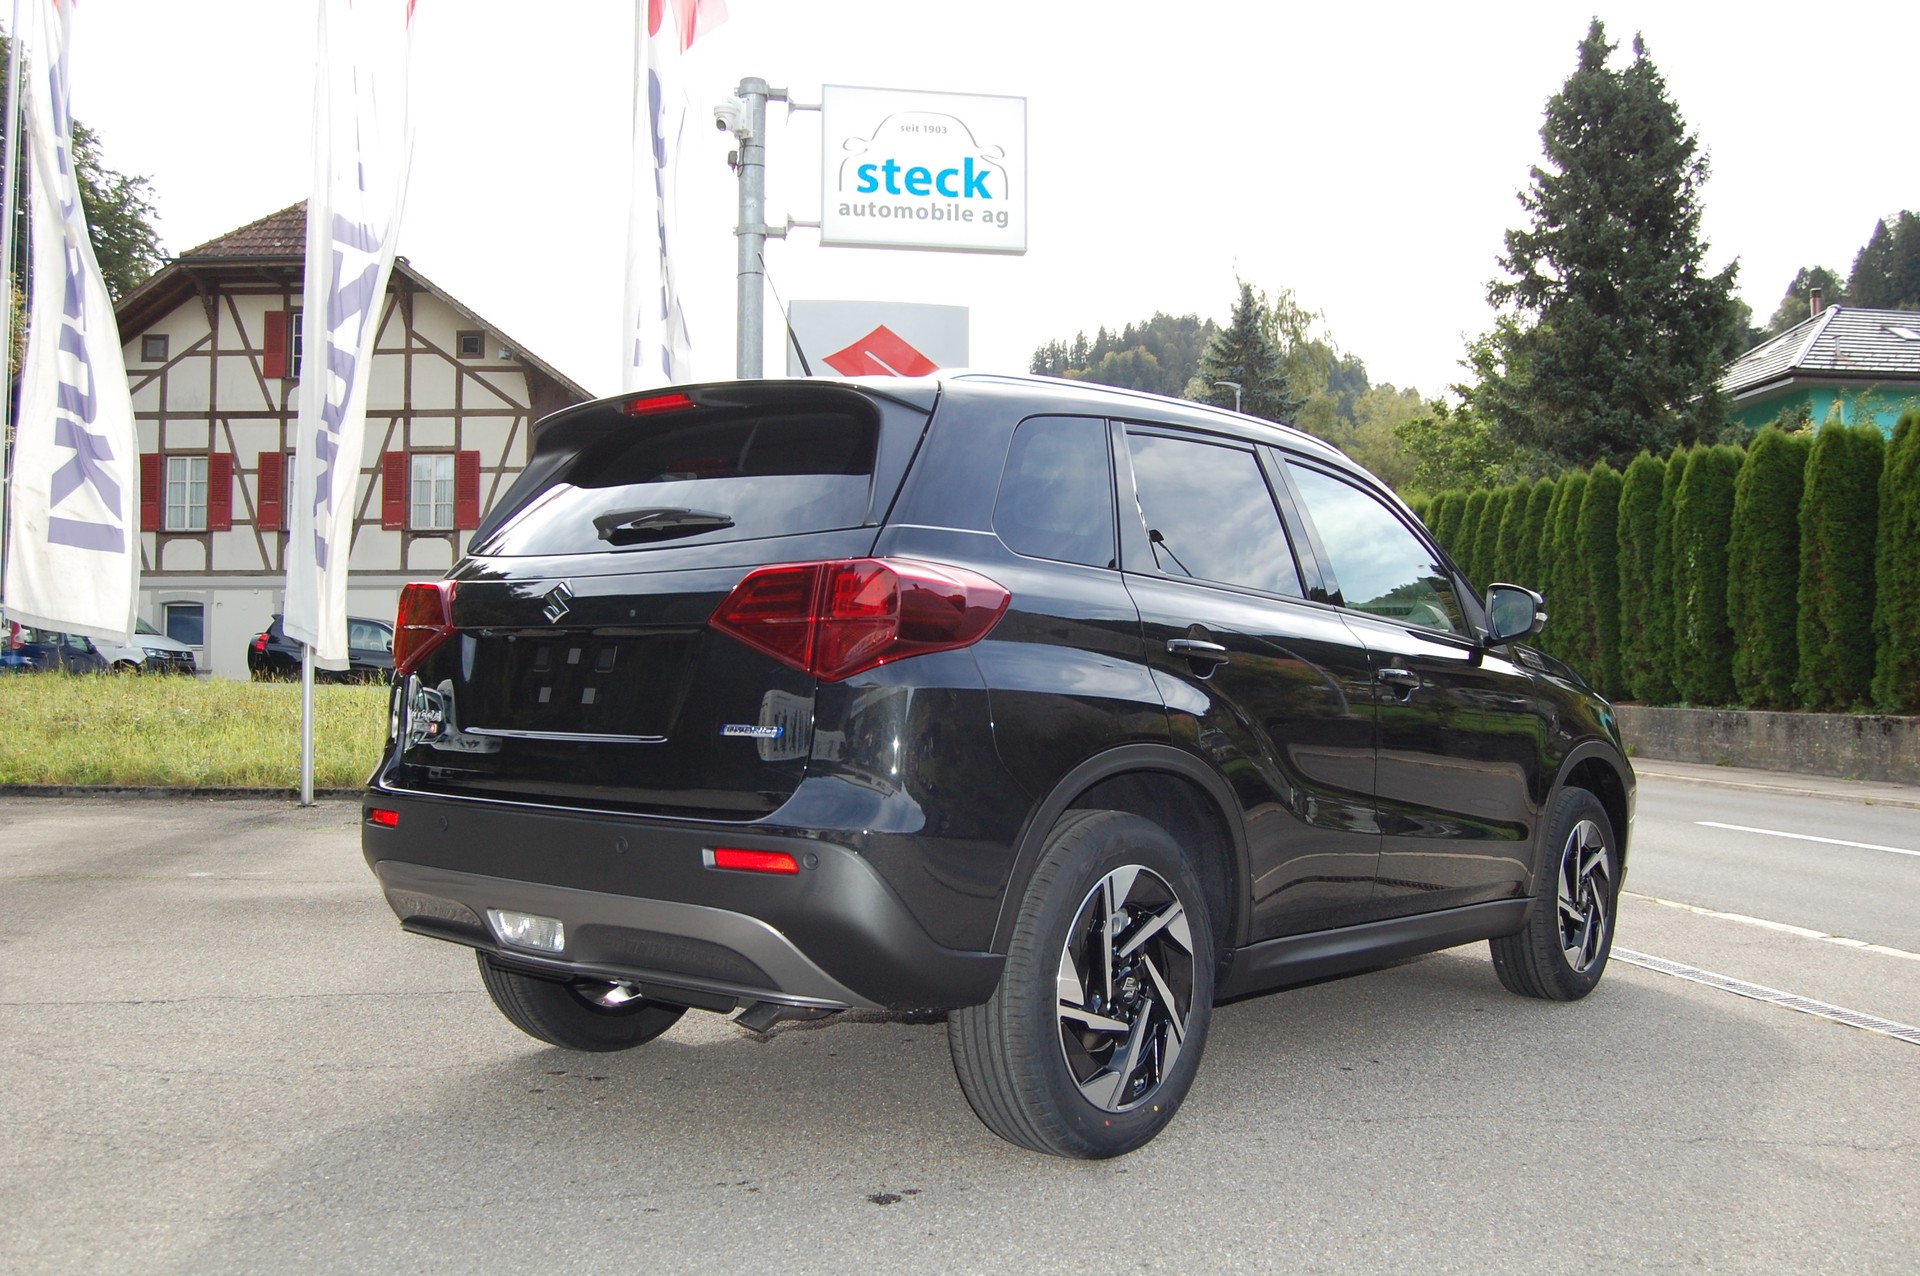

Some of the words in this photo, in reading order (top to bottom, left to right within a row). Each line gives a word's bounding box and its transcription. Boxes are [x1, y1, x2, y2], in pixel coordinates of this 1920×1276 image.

[900, 124, 919, 133] seit
[923, 125, 948, 134] 1903
[856, 156, 993, 199] steck
[838, 201, 974, 222] automobile
[981, 209, 1009, 228] ag
